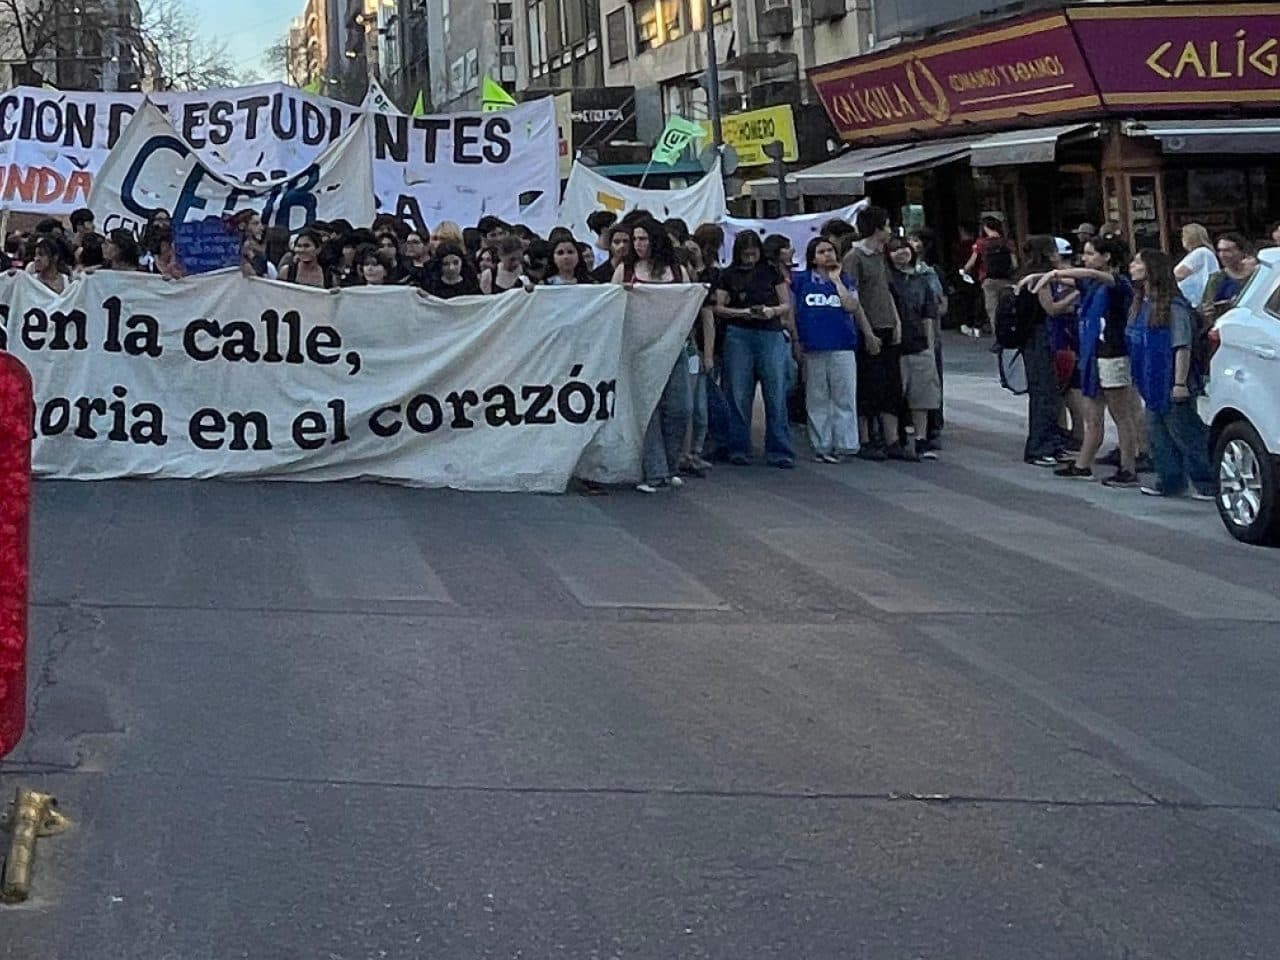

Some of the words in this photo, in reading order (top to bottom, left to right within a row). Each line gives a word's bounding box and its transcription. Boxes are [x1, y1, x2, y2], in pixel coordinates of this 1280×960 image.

[183, 93, 511, 164] ESTUDINTES
[832, 81, 914, 126] CALÍGULA
[22, 309, 87, 351] en
[103, 296, 163, 358] la
[183, 309, 363, 375] calle,
[32, 384, 168, 445] oria
[188, 406, 271, 451] en
[292, 398, 350, 451] el
[369, 364, 617, 438] corazón
